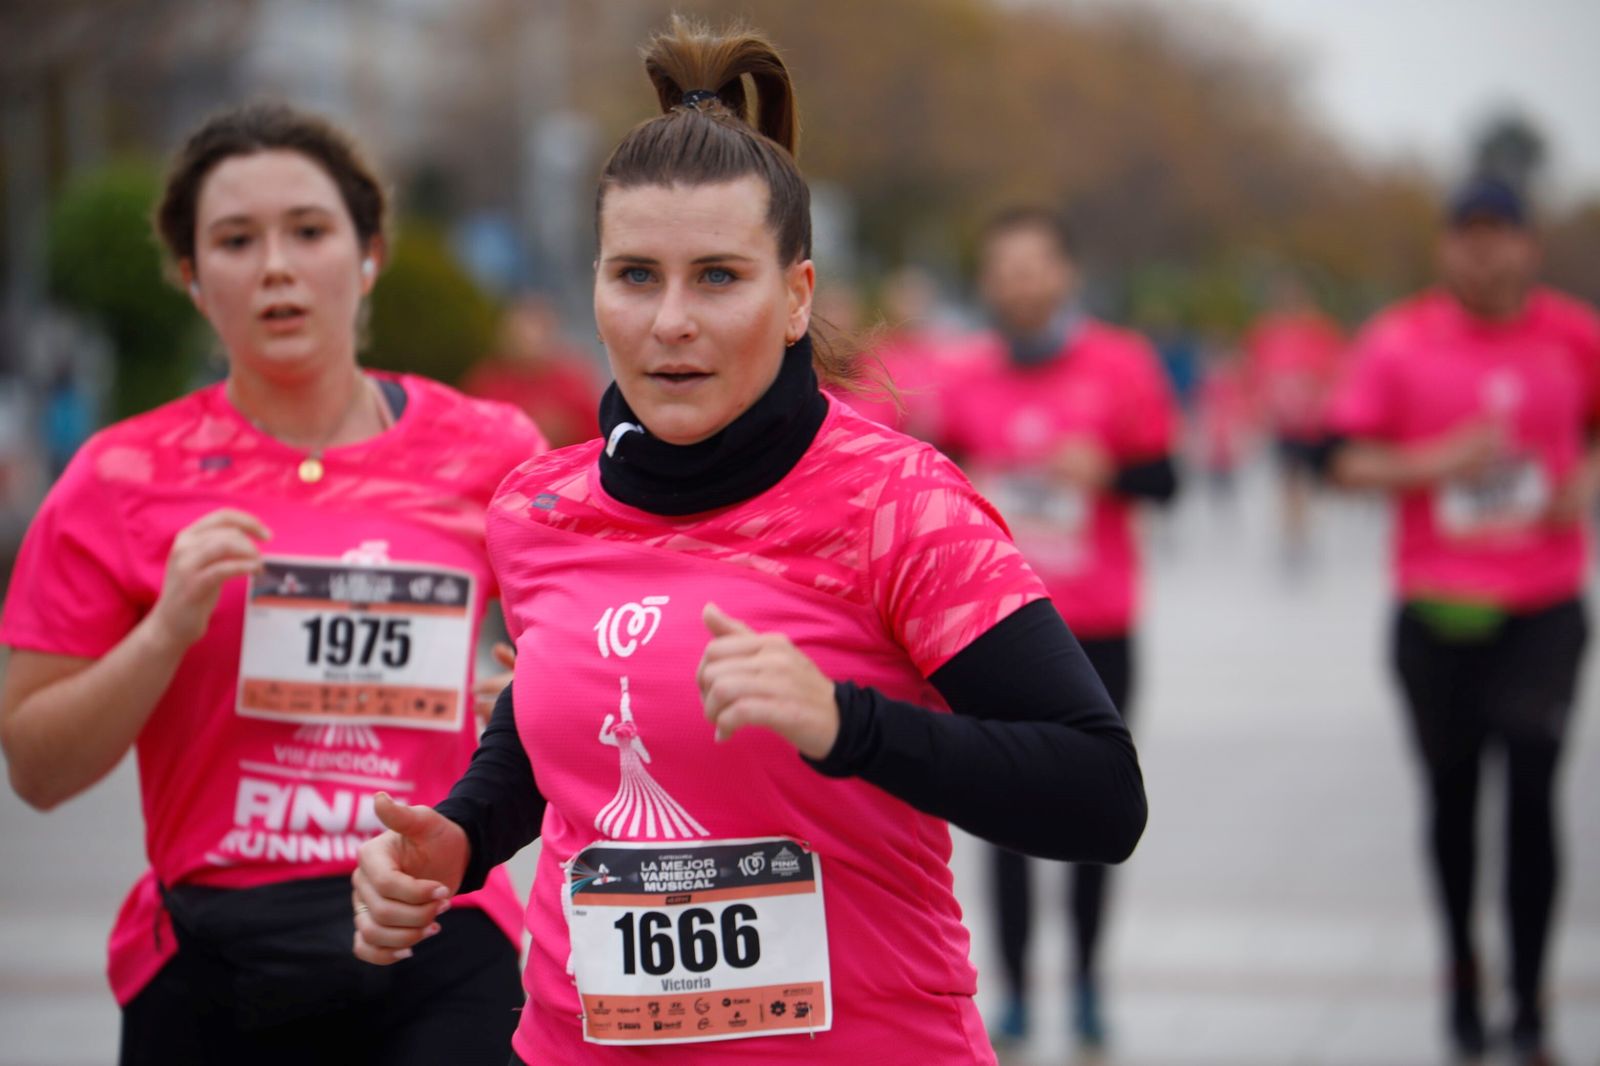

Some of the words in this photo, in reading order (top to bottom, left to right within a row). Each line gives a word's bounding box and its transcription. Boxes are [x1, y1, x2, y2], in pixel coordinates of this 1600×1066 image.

[302, 615, 412, 668] 1975
[641, 861, 659, 872] LA
[661, 858, 715, 871] MEJOR
[640, 868, 717, 882] VARIEDAD
[644, 879, 714, 892] MUSICAL
[614, 903, 761, 975] 1666
[661, 976, 712, 992] Victoria
